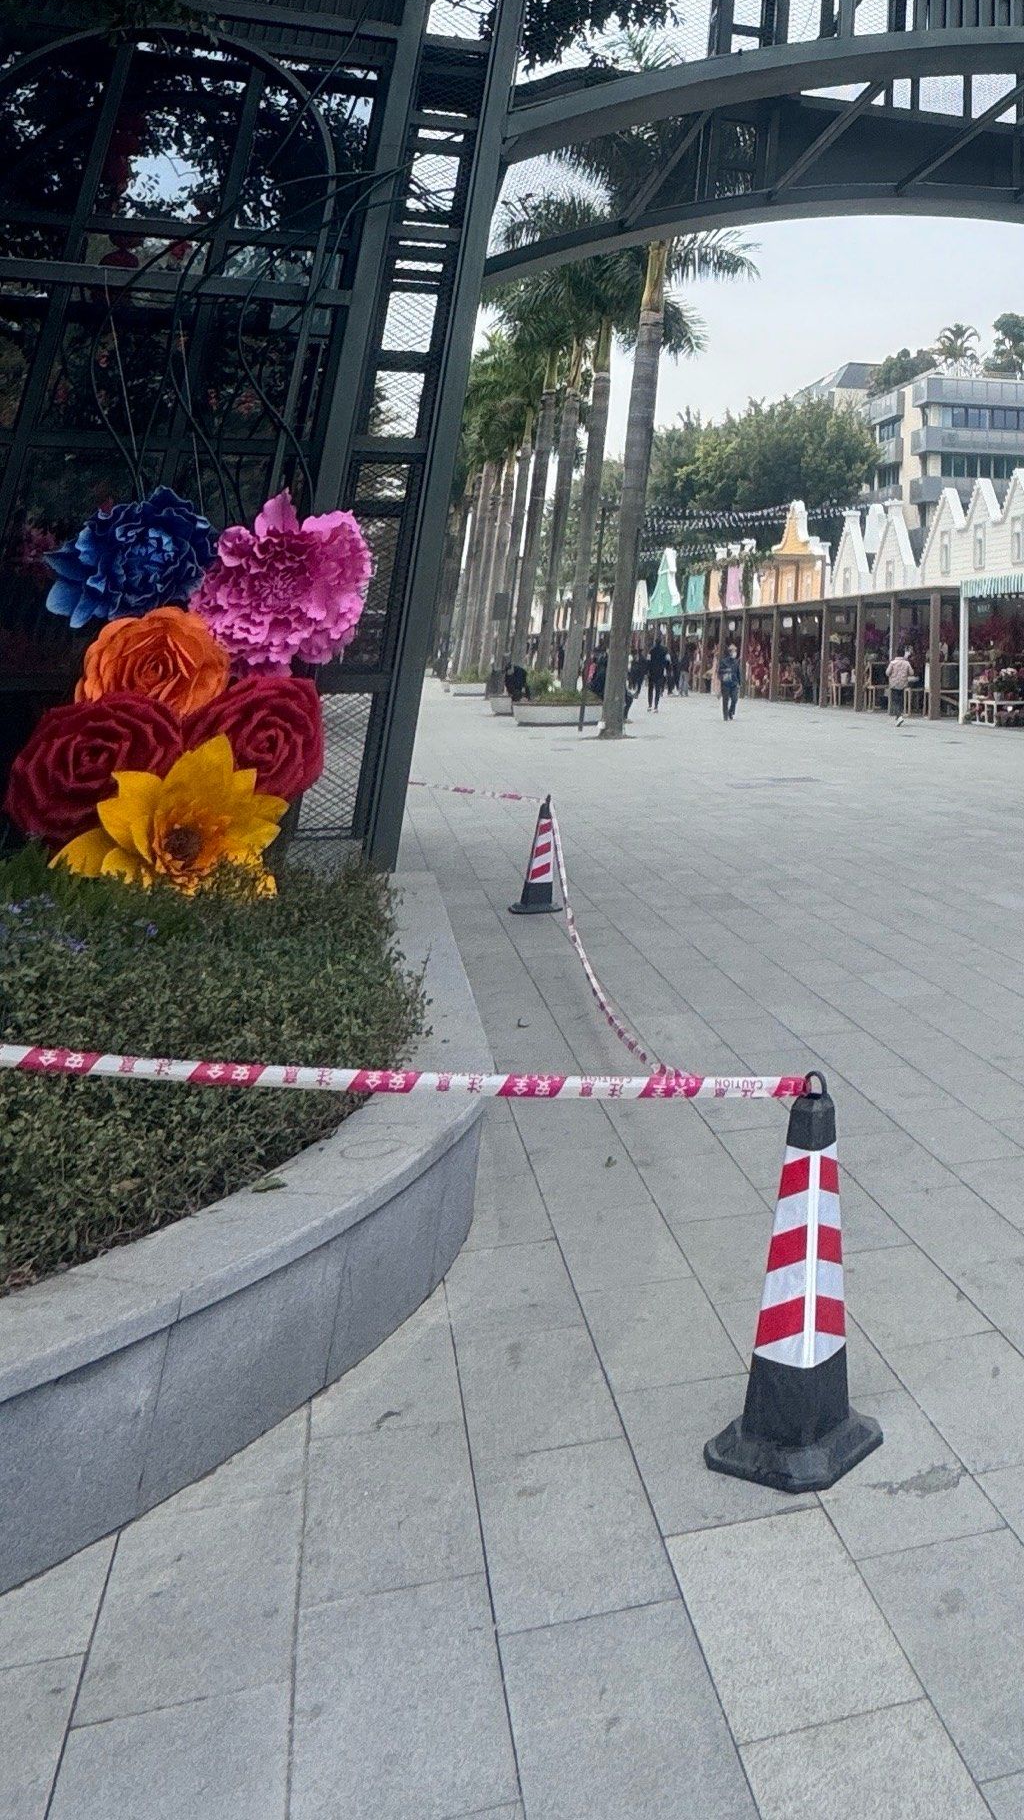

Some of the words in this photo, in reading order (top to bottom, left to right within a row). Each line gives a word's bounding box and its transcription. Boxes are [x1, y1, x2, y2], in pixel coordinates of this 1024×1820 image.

[38, 1049, 85, 1069] 安全
[206, 1064, 249, 1081] 安全
[365, 1071, 406, 1090] 安全
[436, 1074, 483, 1093] 注意
[512, 1077, 551, 1096] 安全
[579, 1082, 624, 1098] 注意
[714, 1078, 764, 1090] CAUTION
